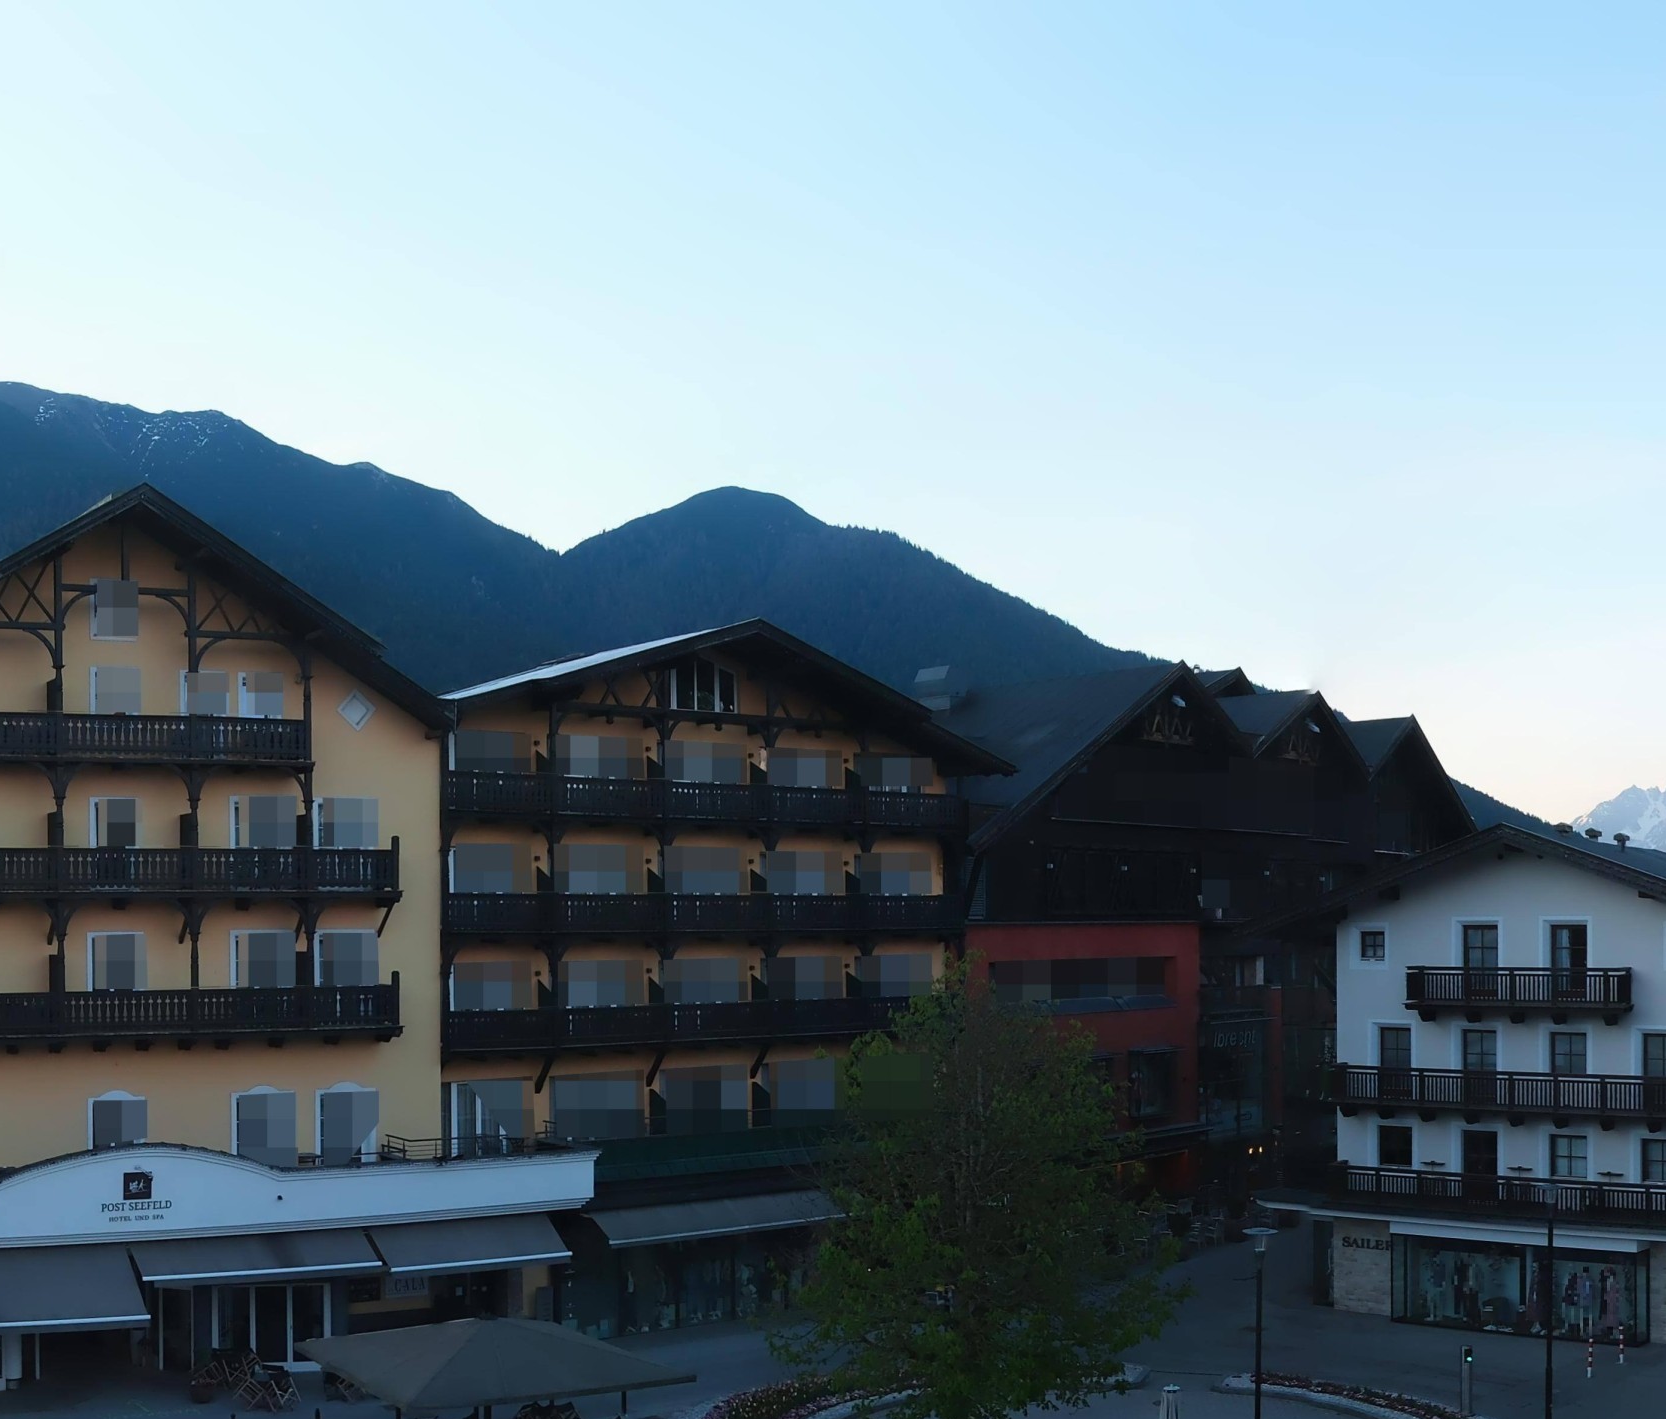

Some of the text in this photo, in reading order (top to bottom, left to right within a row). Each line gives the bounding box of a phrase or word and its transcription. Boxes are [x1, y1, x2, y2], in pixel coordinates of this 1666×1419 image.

[101, 1200, 172, 1212] POST SEEFELD
[109, 1215, 132, 1223] HOTEL
